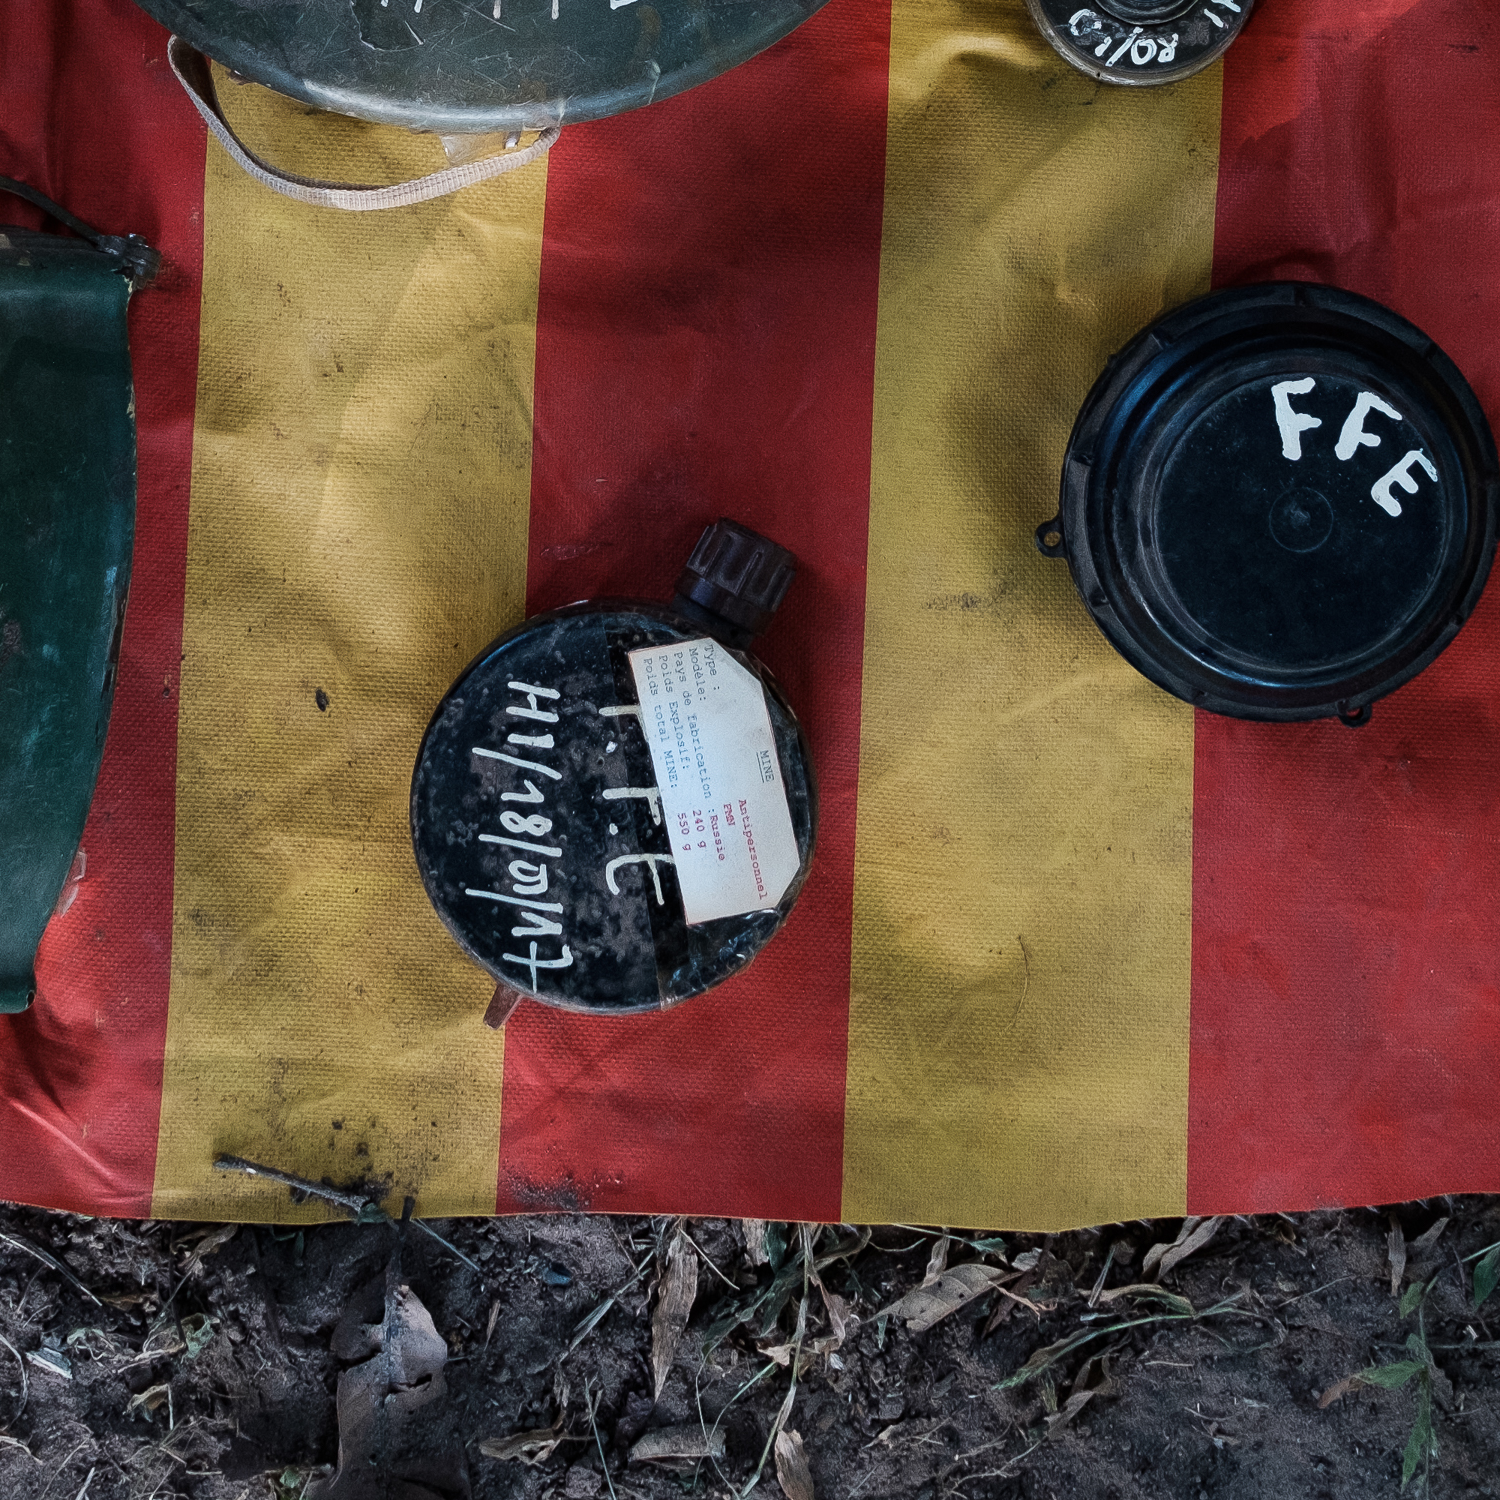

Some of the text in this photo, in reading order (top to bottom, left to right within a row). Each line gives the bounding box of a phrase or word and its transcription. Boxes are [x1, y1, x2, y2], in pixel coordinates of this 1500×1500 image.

[1270, 376, 1438, 518] FFE
[671, 651, 688, 682] Pays
[682, 690, 694, 705] de
[643, 657, 659, 696] Poids
[653, 704, 669, 741] total
[663, 750, 679, 788] MINE:
[677, 811, 690, 835] 550
[658, 654, 675, 693] Poids
[668, 701, 691, 770] Explosif:
[692, 808, 705, 832] 240
[687, 713, 713, 798] fabrication
[702, 644, 718, 676] Type
[738, 798, 766, 900] Antipersonnel
[759, 750, 774, 781] MINE
